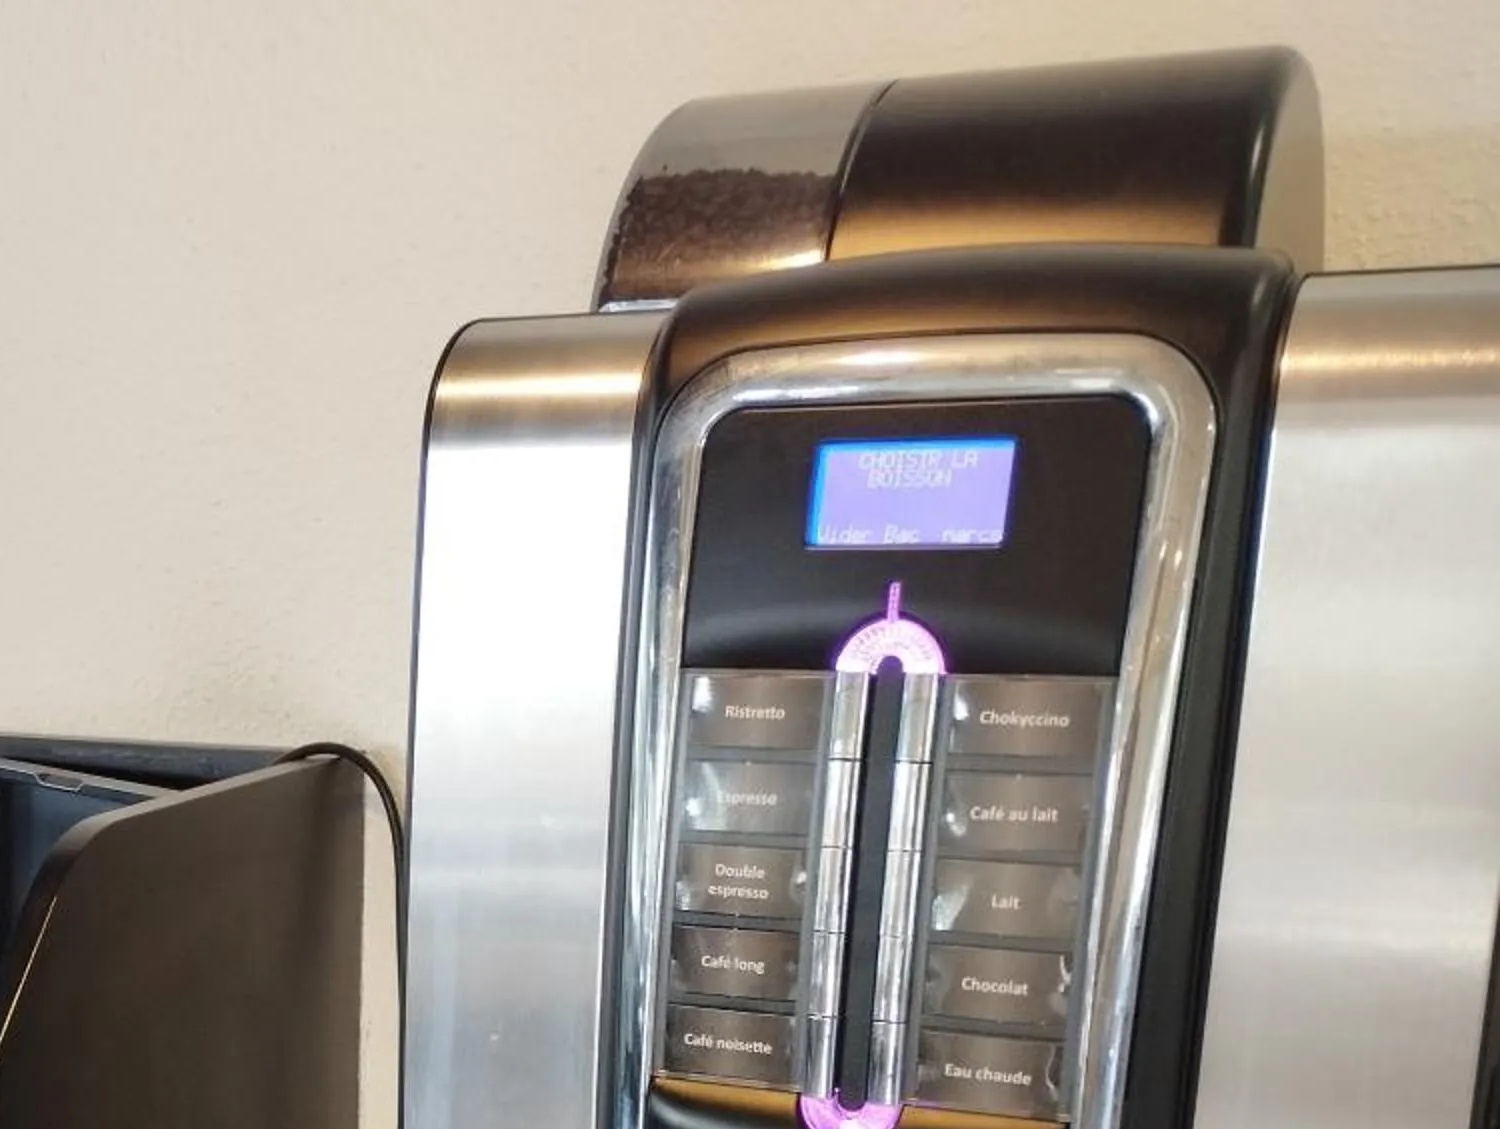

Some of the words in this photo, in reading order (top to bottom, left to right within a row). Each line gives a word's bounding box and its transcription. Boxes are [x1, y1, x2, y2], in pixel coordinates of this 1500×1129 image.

[859, 450, 942, 470] CHOISIR
[951, 449, 978, 468] LA
[867, 468, 952, 489] BOISSON
[725, 705, 786, 721] Ristretto
[979, 710, 1070, 728] Chokyccino
[970, 806, 1004, 821] Café
[1009, 810, 1028, 821] au
[1032, 806, 1059, 823] lait
[715, 863, 766, 880] Double
[707, 885, 770, 901] espresso
[991, 894, 1021, 911] Lait
[701, 955, 732, 970] Café
[734, 956, 765, 975] long
[961, 976, 1029, 996] Chocolat
[684, 1033, 714, 1047] Café
[716, 1037, 773, 1056] noisette
[944, 1063, 972, 1079] Eau
[975, 1066, 1032, 1086] chaude
